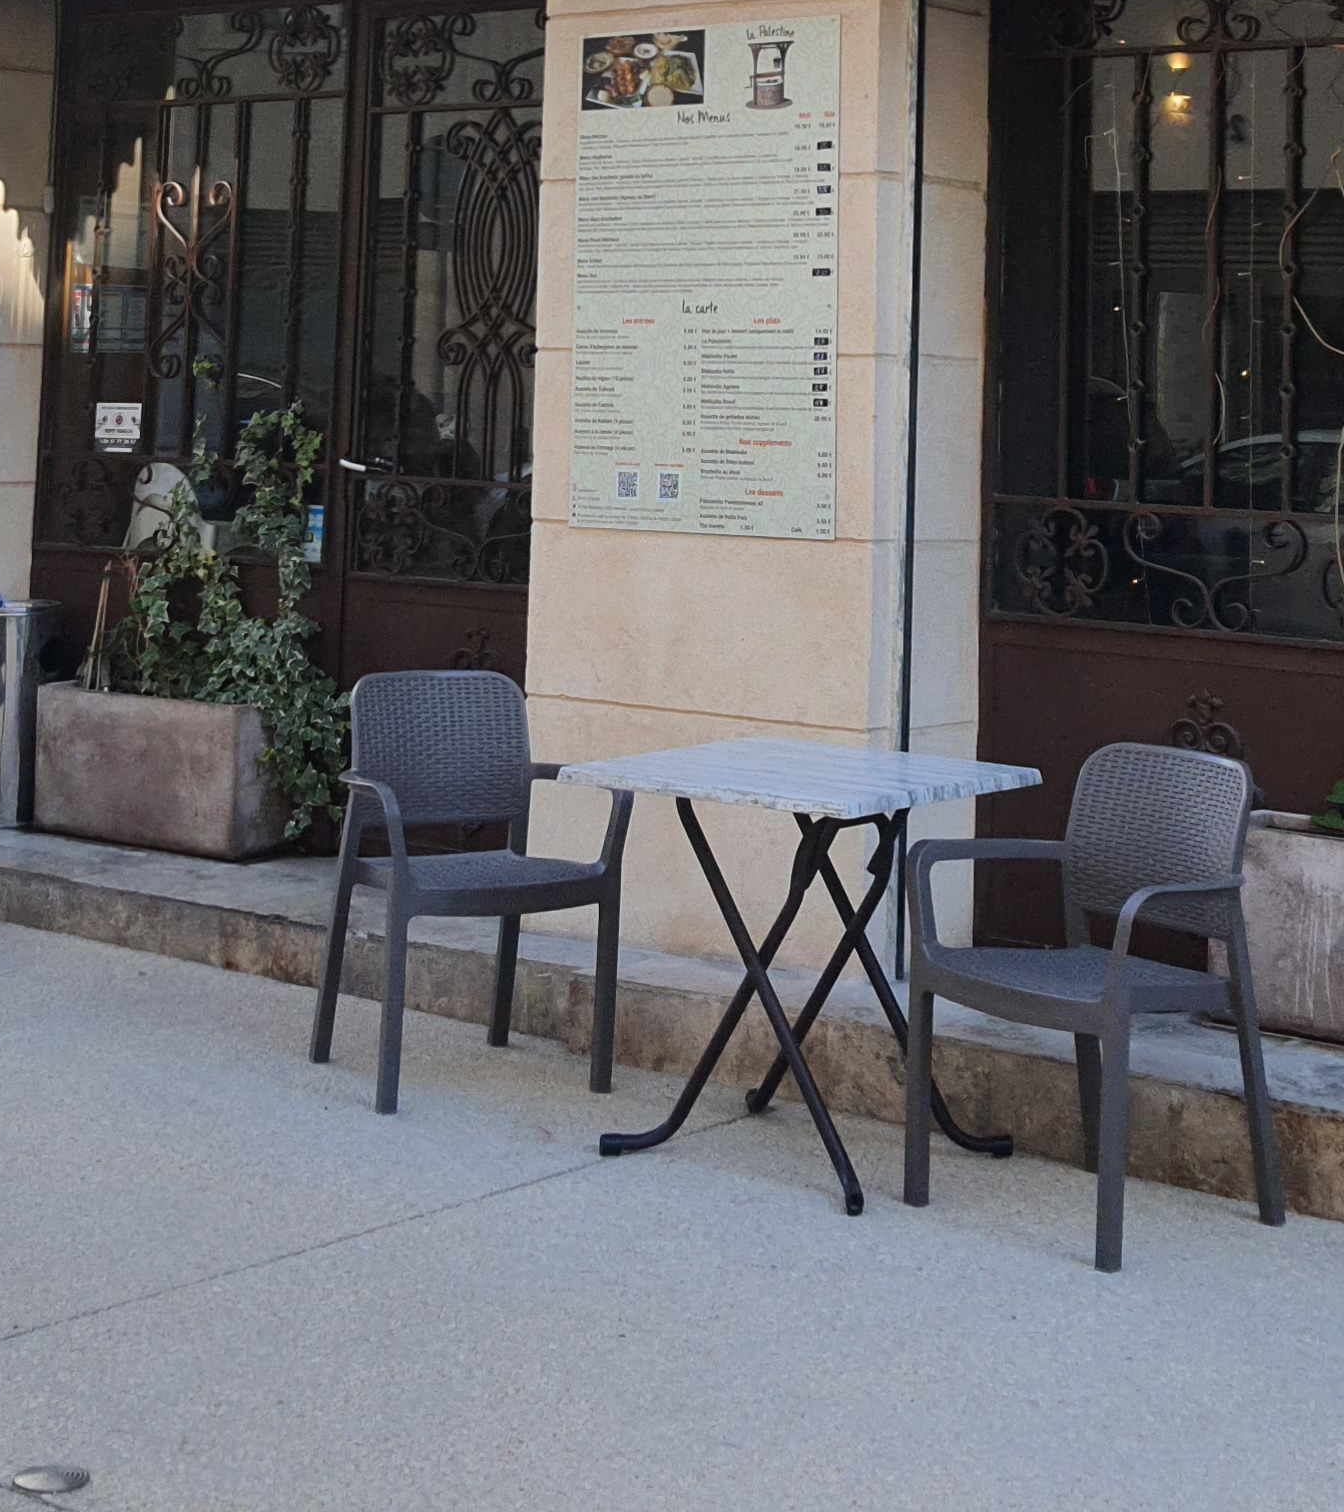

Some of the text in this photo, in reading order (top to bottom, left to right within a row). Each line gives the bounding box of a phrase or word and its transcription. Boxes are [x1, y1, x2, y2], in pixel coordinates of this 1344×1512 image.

[677, 109, 731, 125] Nos Menus
[695, 300, 719, 314] carte
